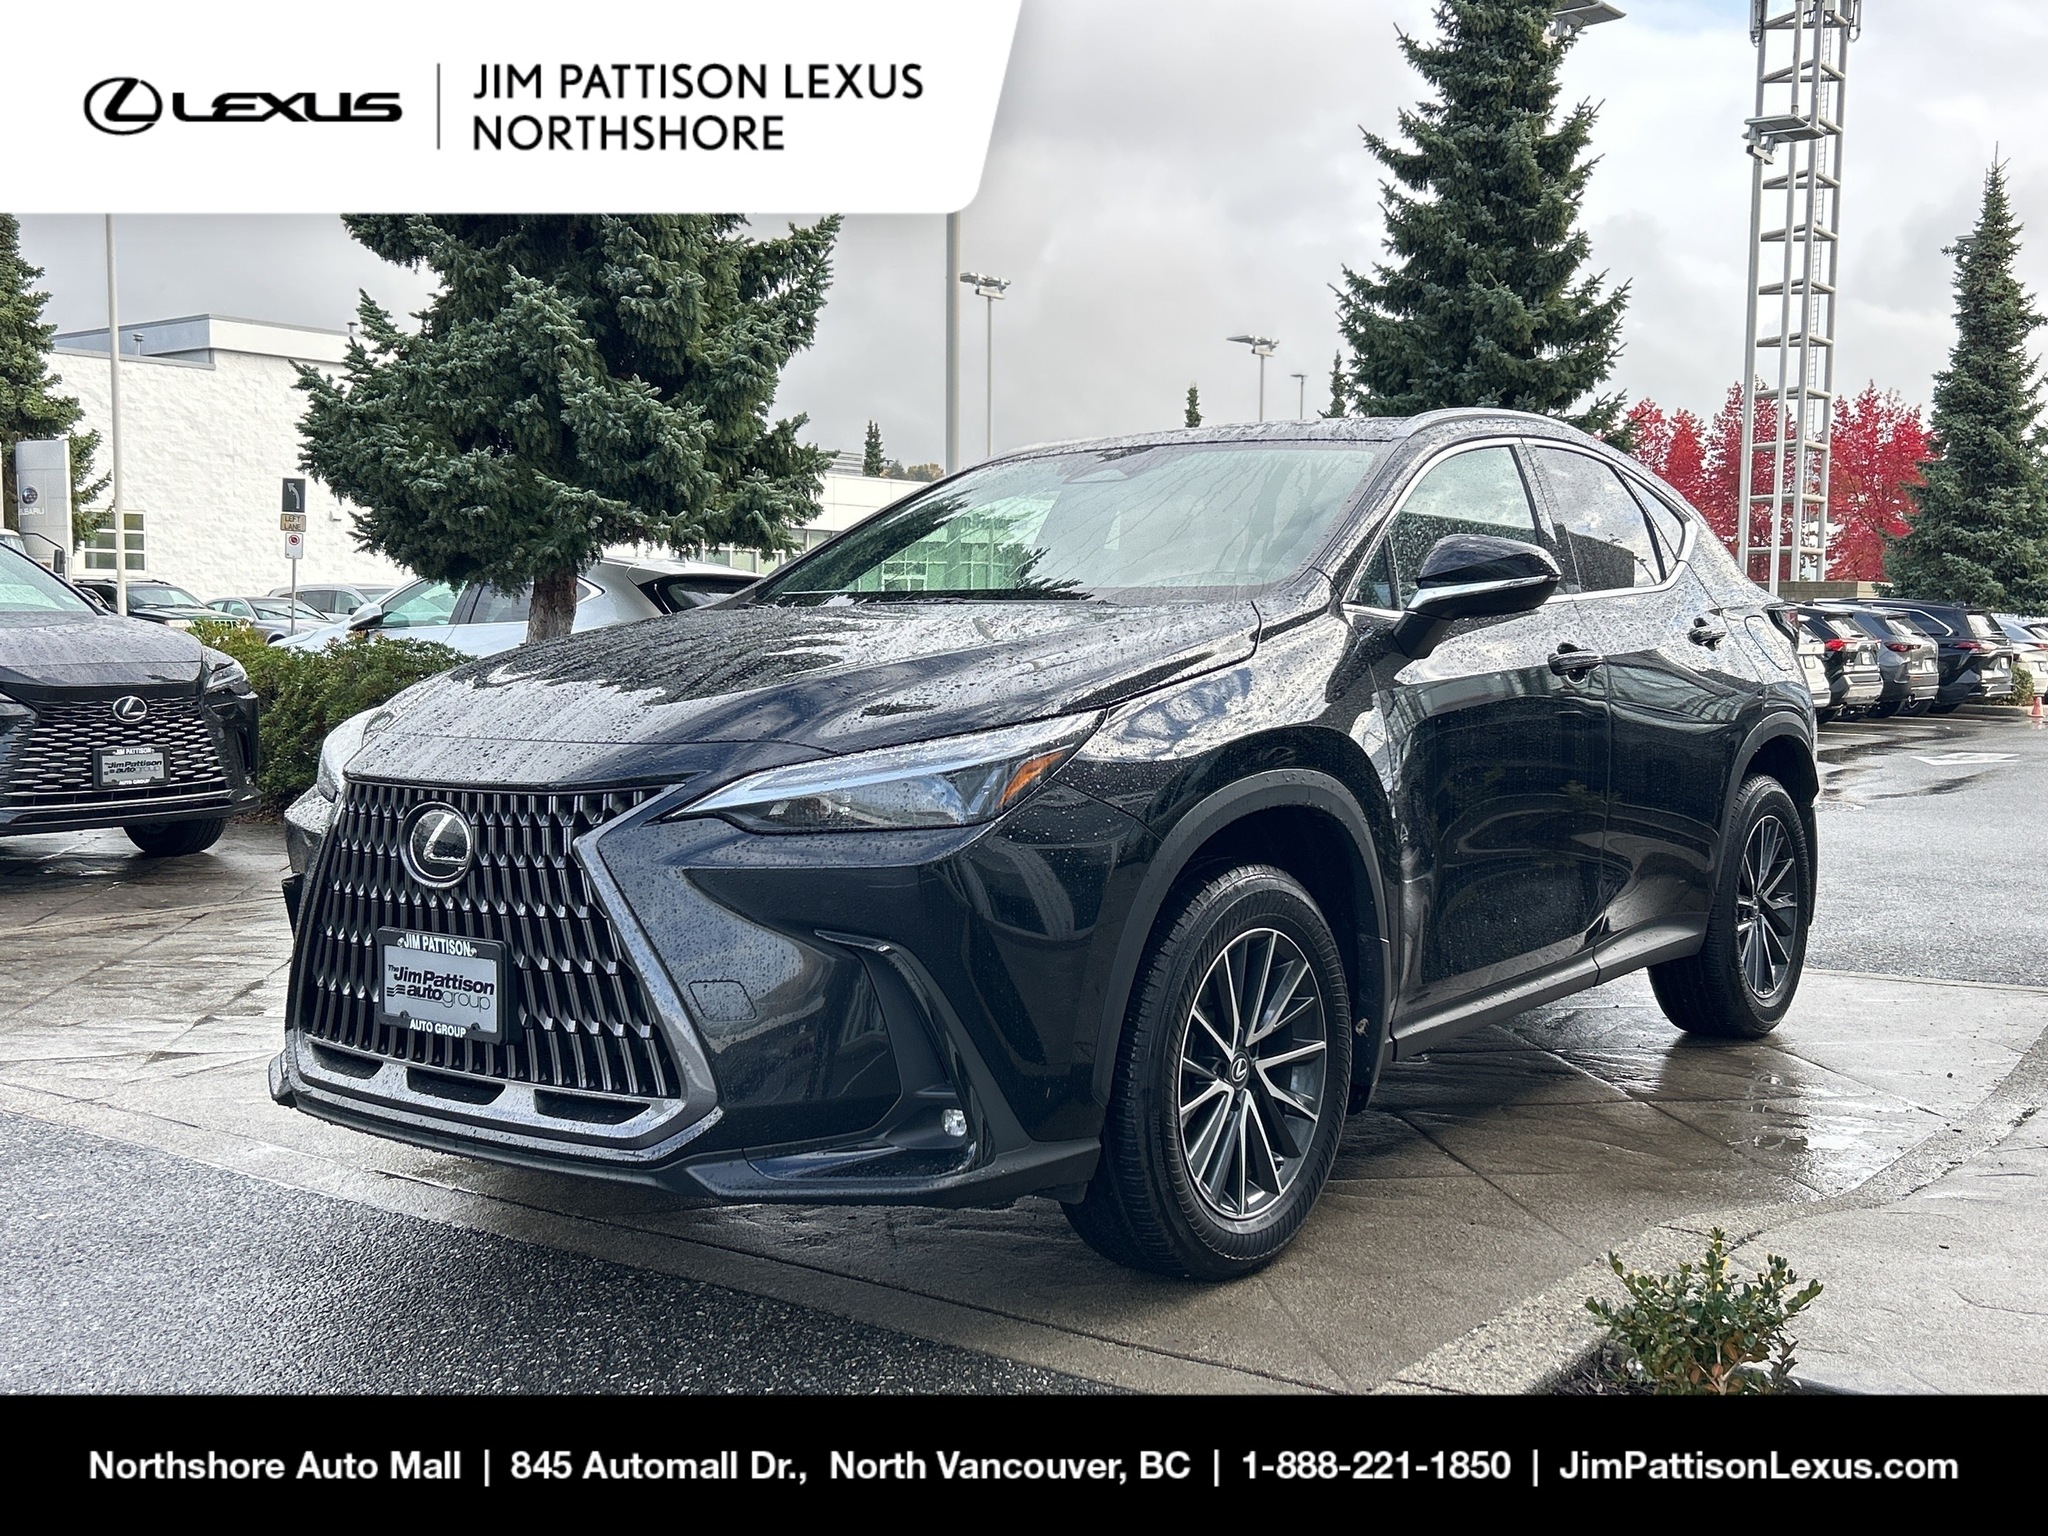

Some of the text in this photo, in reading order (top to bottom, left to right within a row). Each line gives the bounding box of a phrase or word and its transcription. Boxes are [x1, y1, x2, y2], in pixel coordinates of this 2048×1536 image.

[285, 515, 301, 523] LEFT
[284, 523, 301, 531] LANE
[404, 933, 472, 957] JIM PATTISON
[387, 964, 399, 974] The
[393, 966, 495, 996] JimPattison
[409, 1018, 467, 1038] AUTO GROUP
